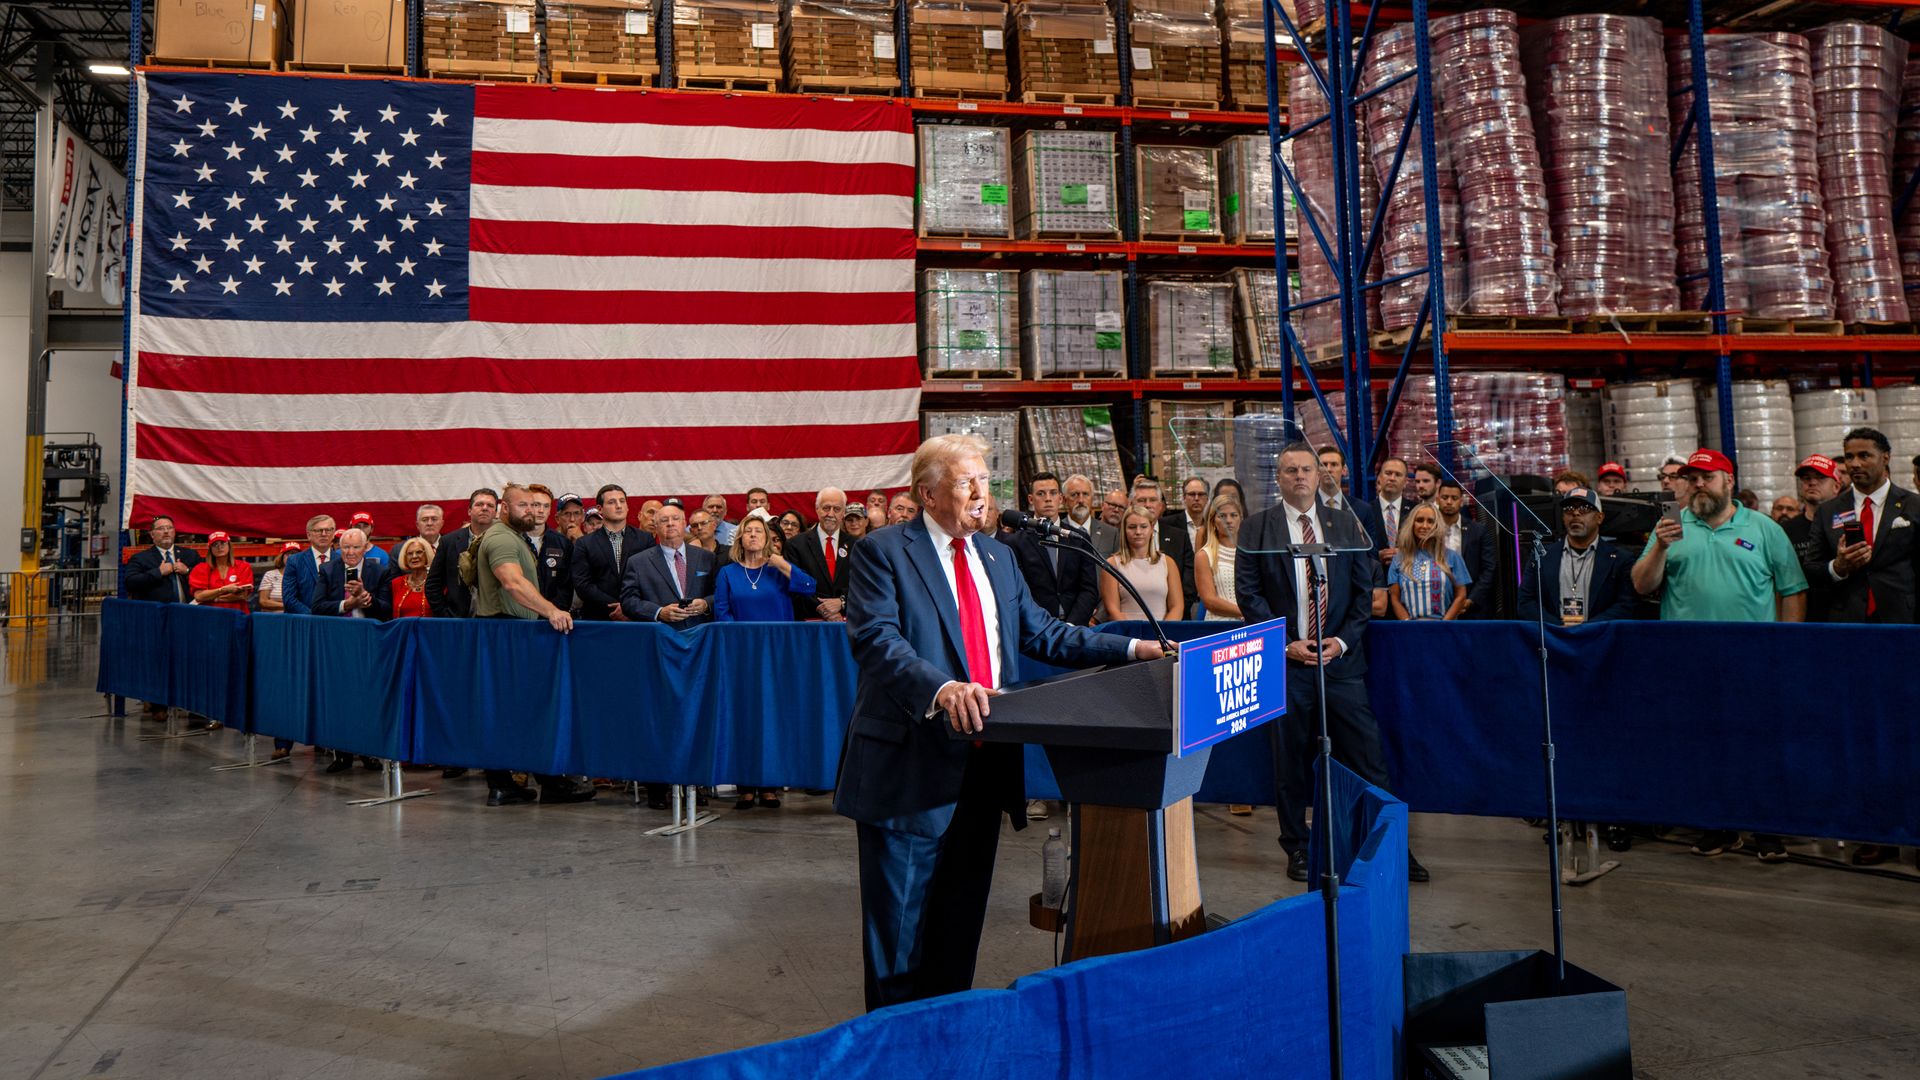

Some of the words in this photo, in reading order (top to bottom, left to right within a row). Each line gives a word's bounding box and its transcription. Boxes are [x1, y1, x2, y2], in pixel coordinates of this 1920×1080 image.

[195, 1, 225, 19] Blue
[1214, 648, 1229, 663] TEXT
[1239, 643, 1246, 656] TO
[1213, 654, 1262, 693] TRUMP
[1219, 681, 1257, 714] VANCE
[1231, 717, 1247, 734] 2024
